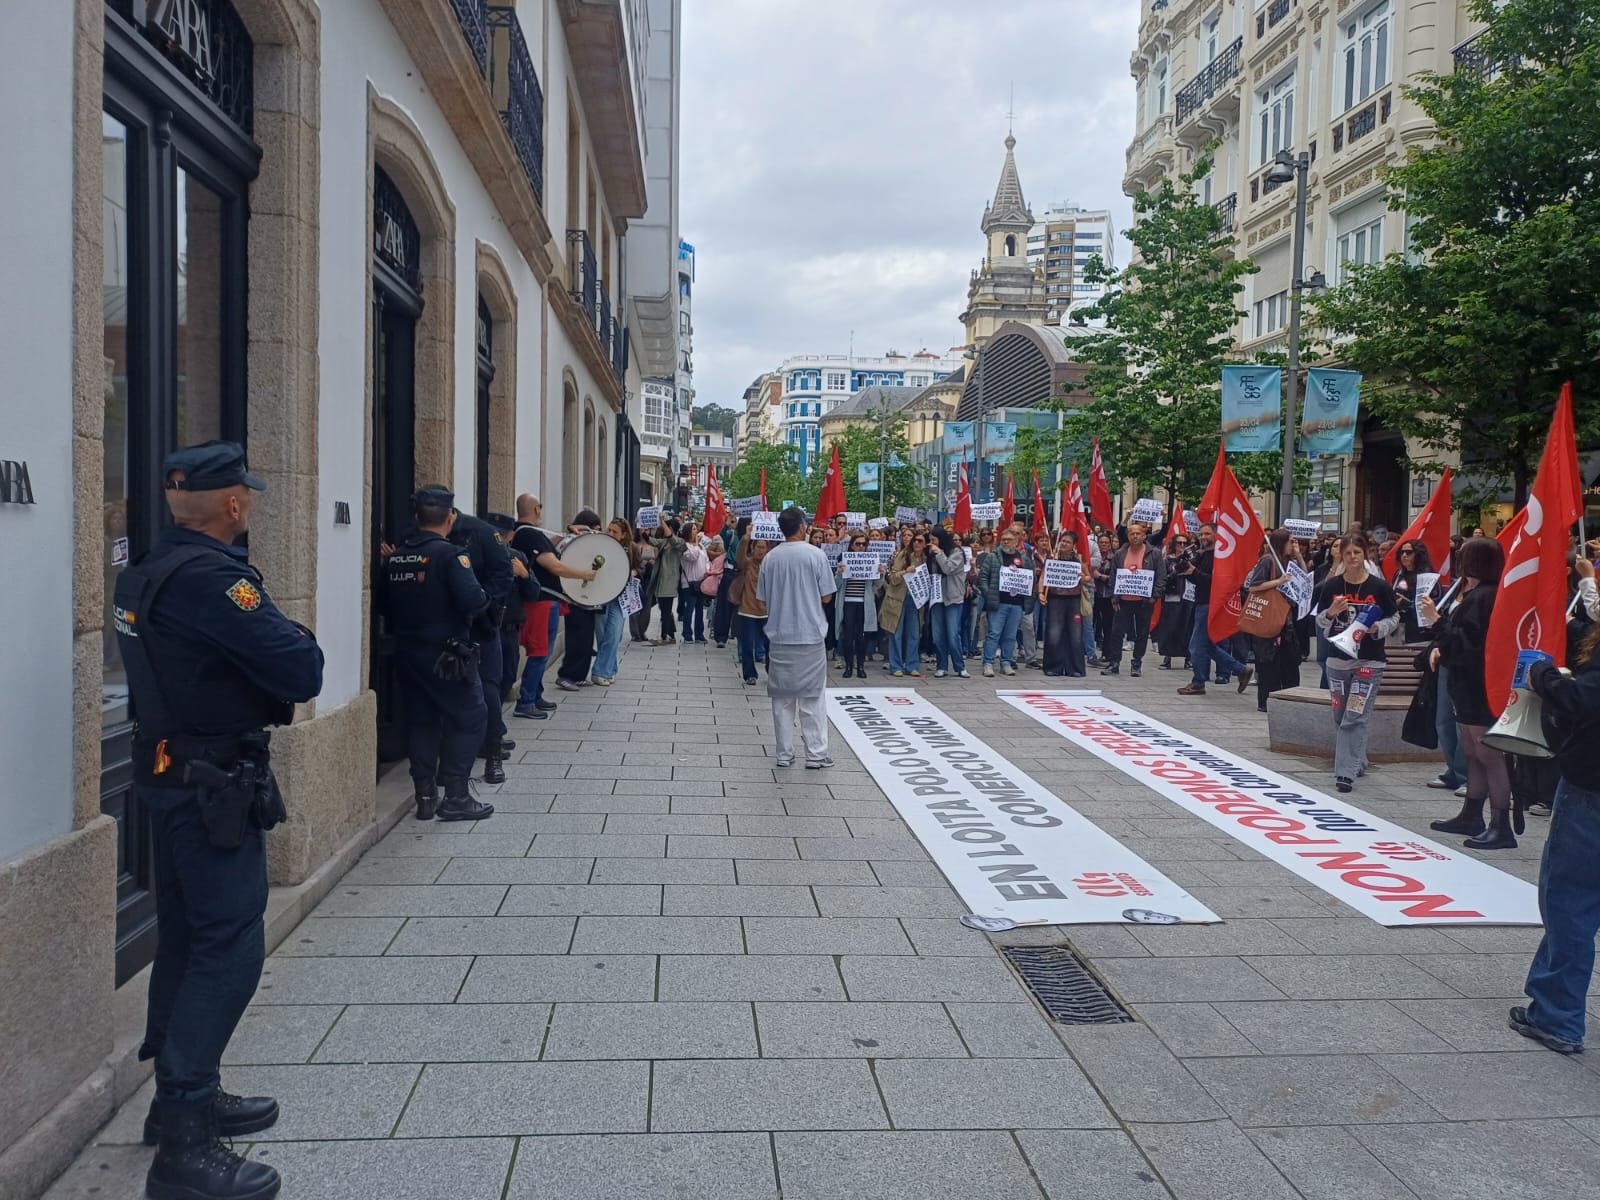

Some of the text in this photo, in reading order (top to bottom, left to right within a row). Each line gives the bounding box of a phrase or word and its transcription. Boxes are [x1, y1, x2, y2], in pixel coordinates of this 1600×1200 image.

[384, 211, 406, 267] ZARA
[389, 555, 422, 564] POLICIA
[884, 696, 915, 706] UGT
[1083, 705, 1120, 716] UGT
[1058, 719, 1170, 758] PERDER
[1103, 719, 1172, 740] ARTE!
[1152, 738, 1193, 748] de
[900, 716, 1063, 829] COMERCIO VARIO!
[1174, 749, 1282, 789] Convenio
[834, 695, 1069, 902] EN LOITA POLO CONVENIO DE
[1132, 759, 1343, 846] PODEMOS
[1262, 791, 1317, 805] ao
[1071, 872, 1129, 898] CIG
[1295, 851, 1488, 918] NON
